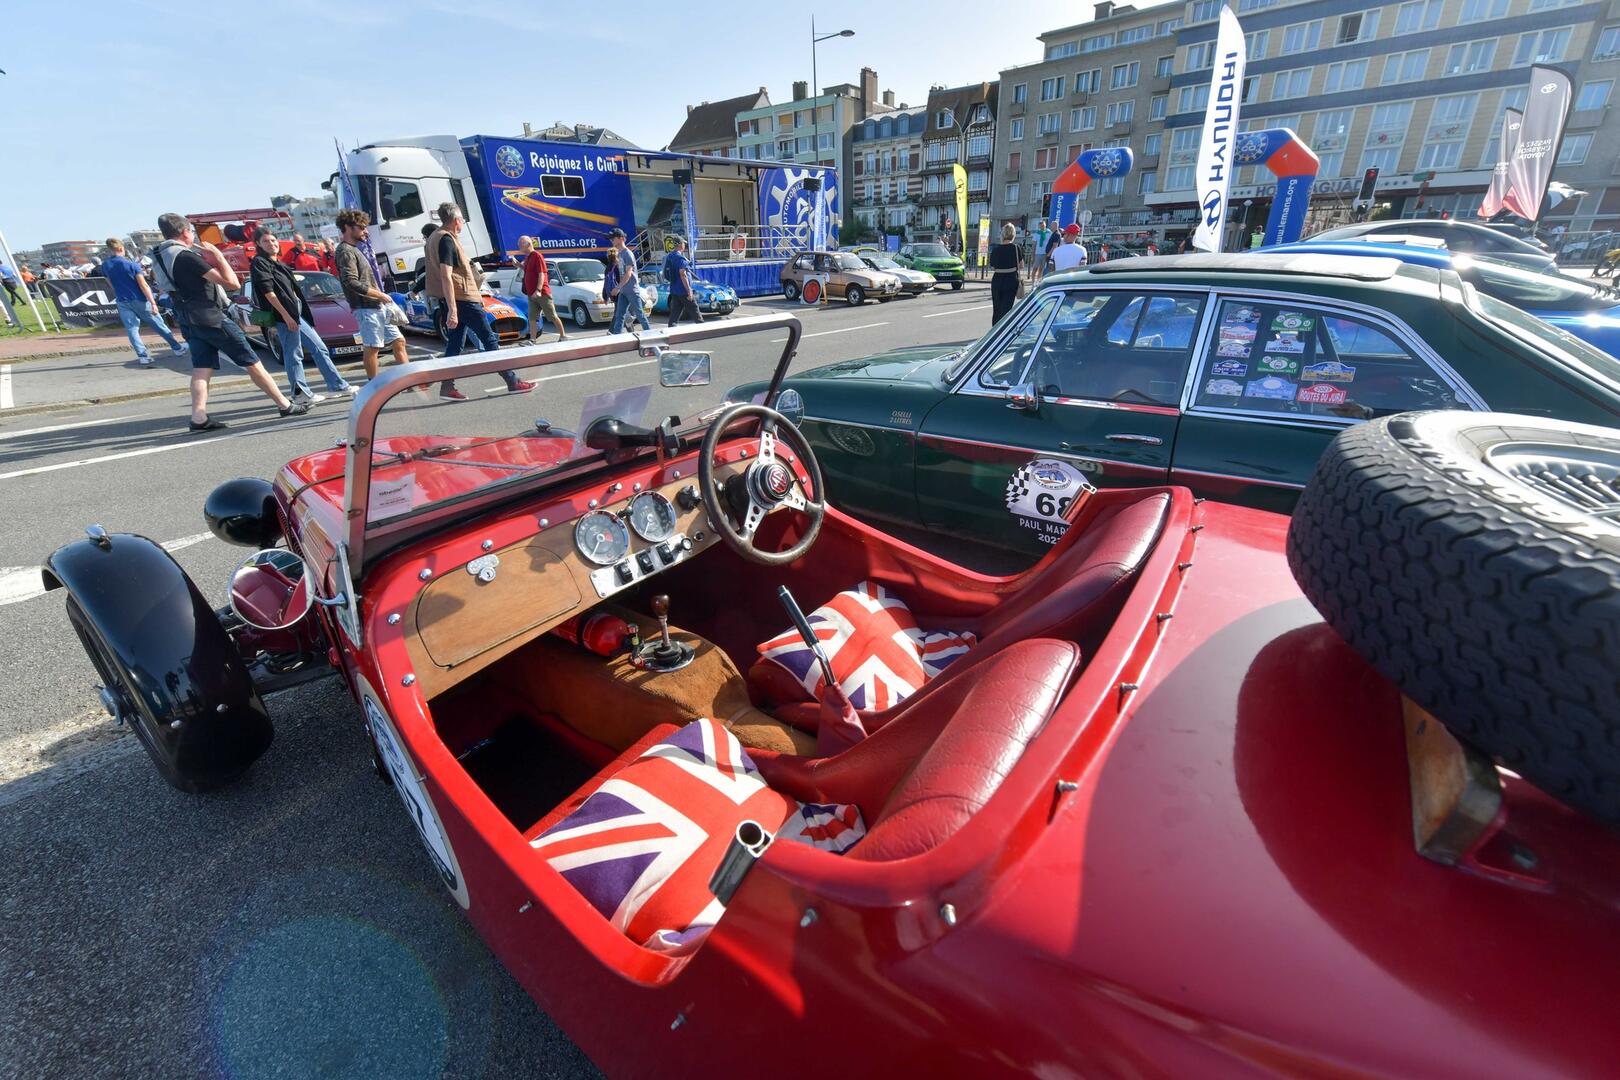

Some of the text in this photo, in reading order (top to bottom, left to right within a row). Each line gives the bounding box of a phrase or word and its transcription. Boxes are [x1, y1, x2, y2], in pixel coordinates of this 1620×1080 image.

[530, 152, 582, 174] Rejoignez
[584, 155, 594, 171] le
[596, 156, 618, 172] Club
[65, 309, 104, 318] Movement
[1019, 518, 1070, 536] PAUL MAR
[1038, 533, 1061, 545] 202
